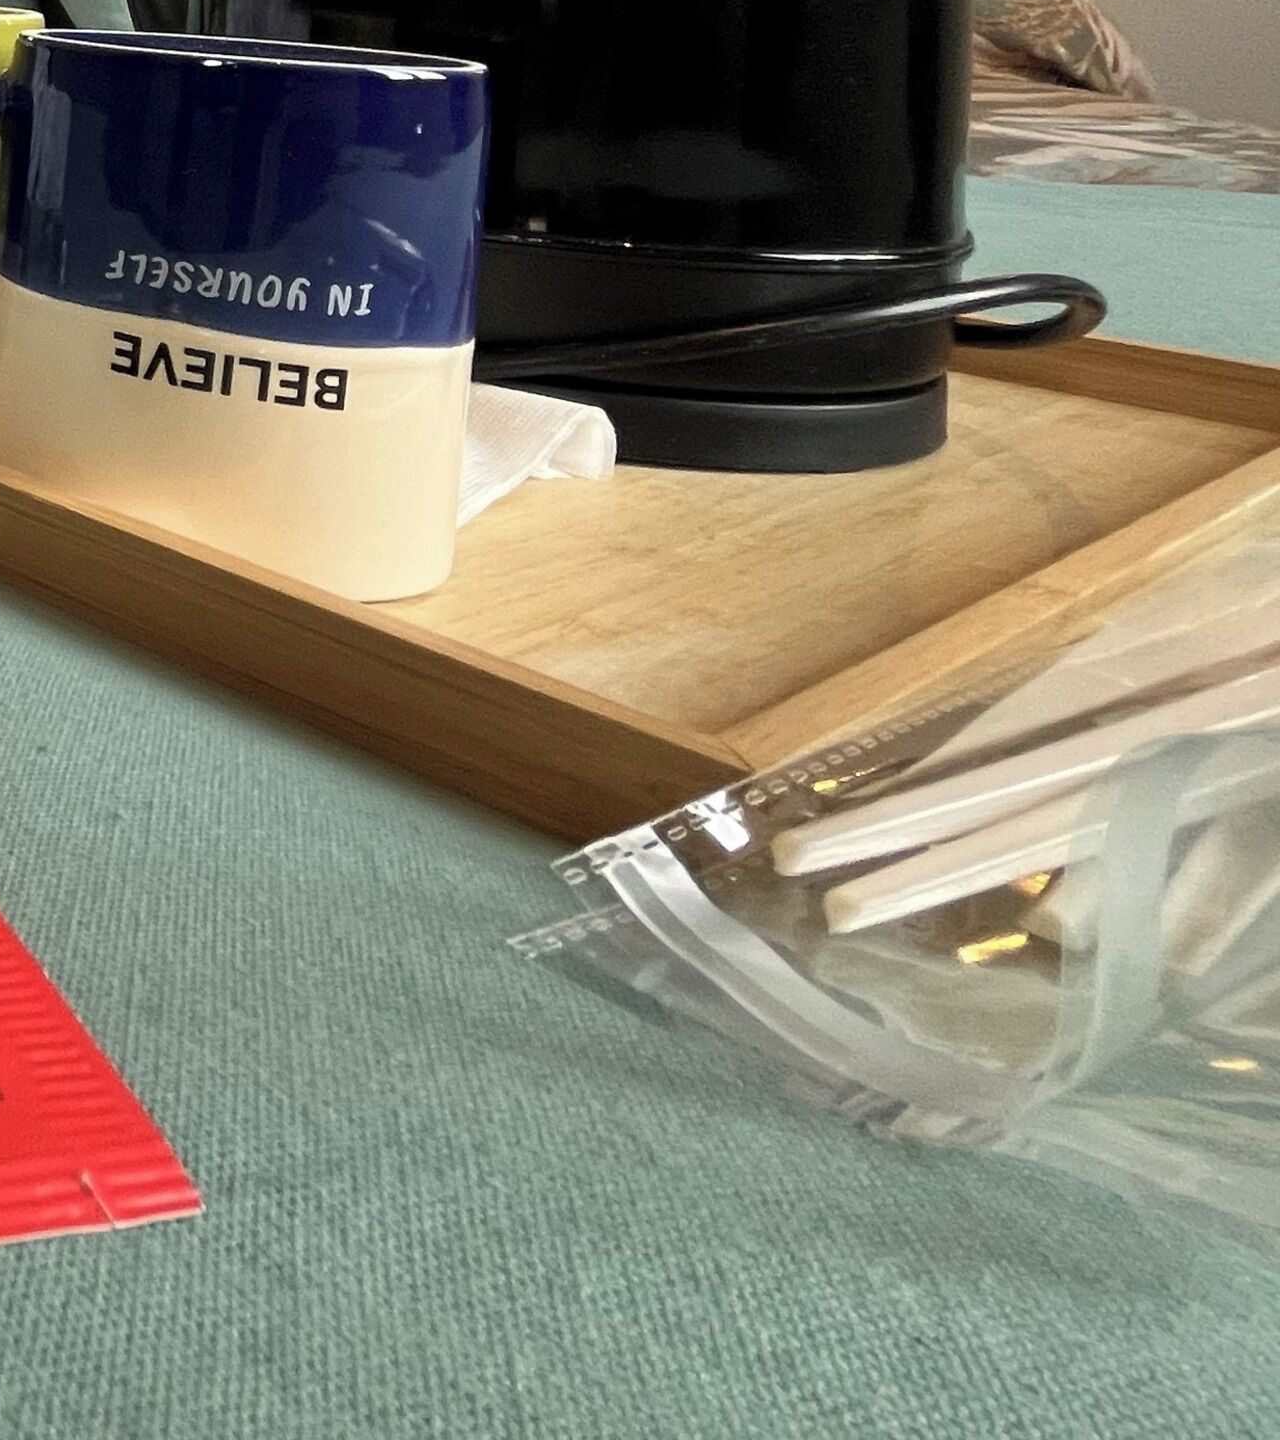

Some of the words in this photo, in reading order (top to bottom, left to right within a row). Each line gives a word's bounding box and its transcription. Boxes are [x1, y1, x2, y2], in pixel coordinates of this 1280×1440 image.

[105, 249, 311, 312] YOURSELF
[327, 283, 374, 317] IN
[110, 331, 348, 411] BELIEVE
